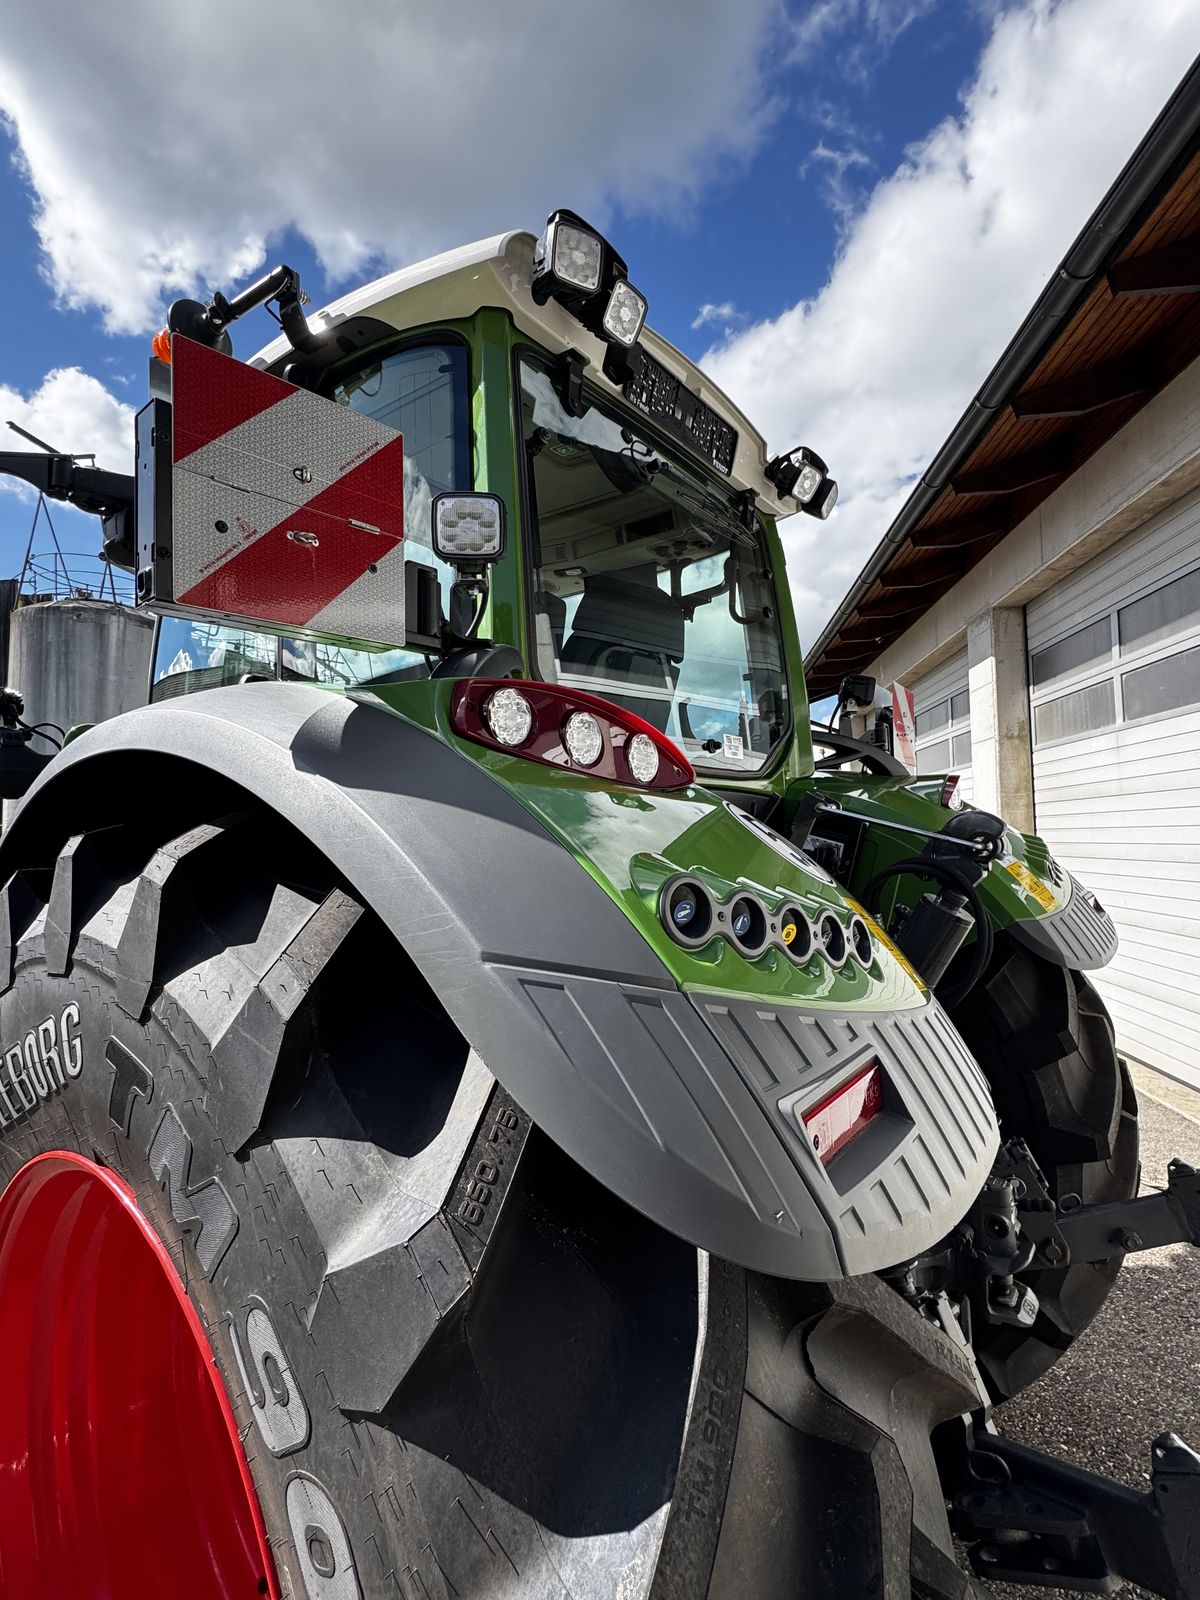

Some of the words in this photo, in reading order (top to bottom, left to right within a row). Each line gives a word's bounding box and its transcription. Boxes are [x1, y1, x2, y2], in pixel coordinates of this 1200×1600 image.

[629, 393, 637, 404] It's
[713, 459, 729, 475] FENDT
[0, 1000, 83, 1128] EBORG
[105, 1034, 240, 1281] TM
[458, 1106, 520, 1228] 650/75
[685, 1459, 716, 1524] TM
[703, 1362, 729, 1447] 900
